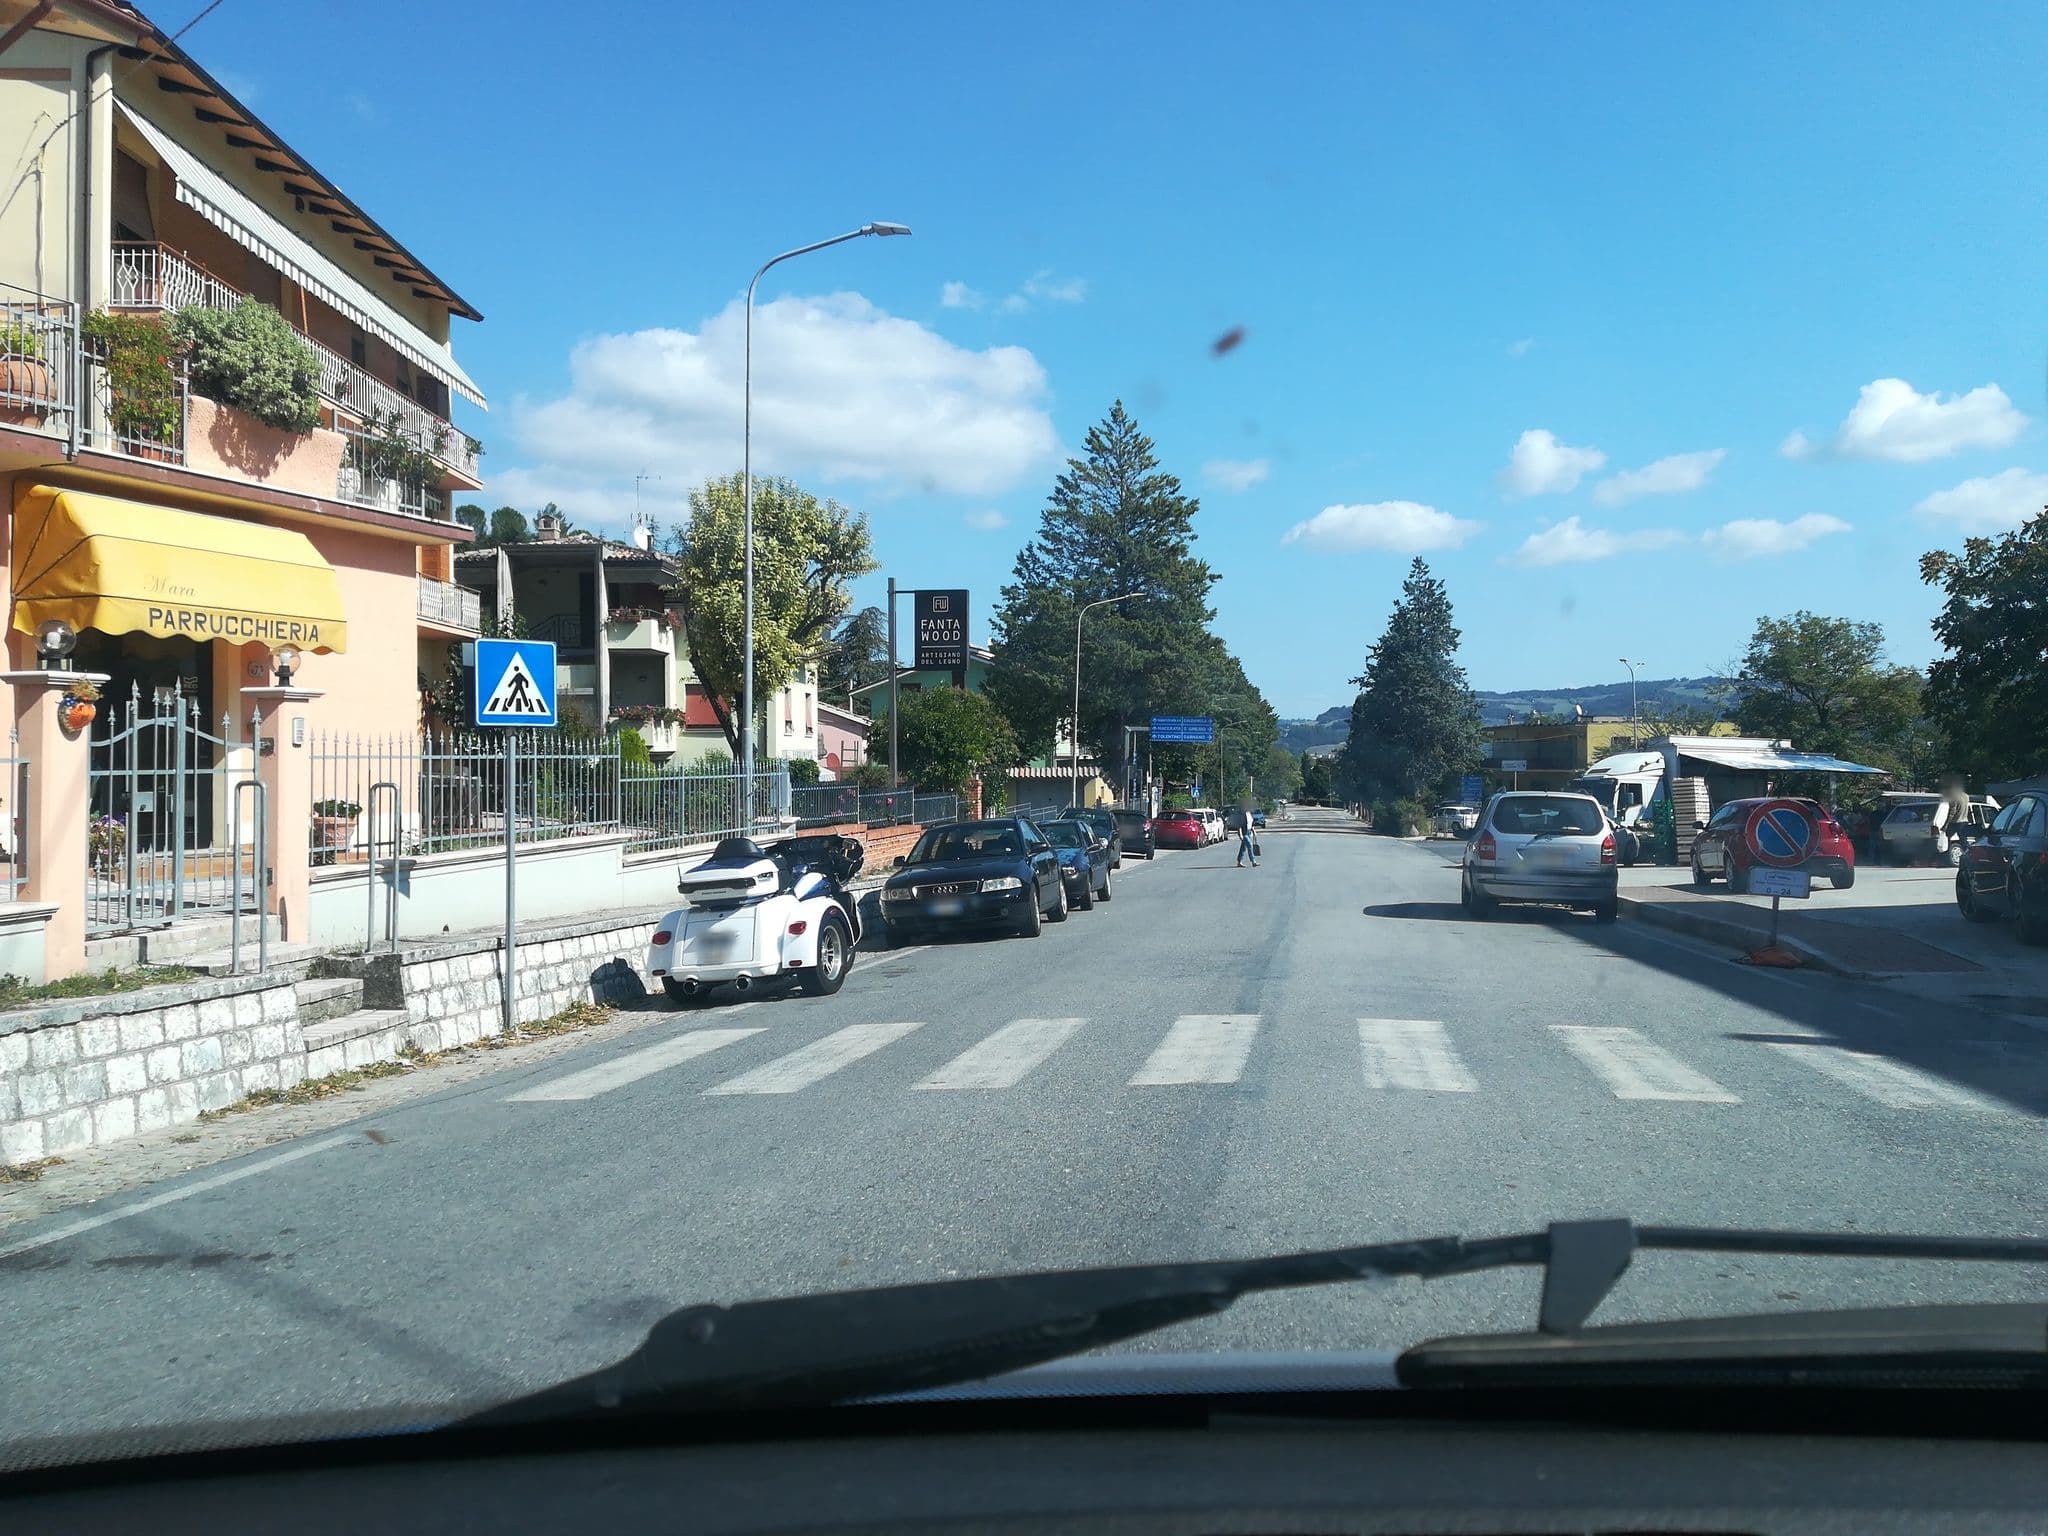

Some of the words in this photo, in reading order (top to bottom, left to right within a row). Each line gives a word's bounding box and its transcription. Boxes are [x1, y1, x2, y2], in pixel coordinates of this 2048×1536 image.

[143, 575, 199, 597] Mara
[148, 607, 319, 643] PARRUCCHIERIA
[921, 619, 961, 630] FANTA
[921, 630, 961, 642] WOOD
